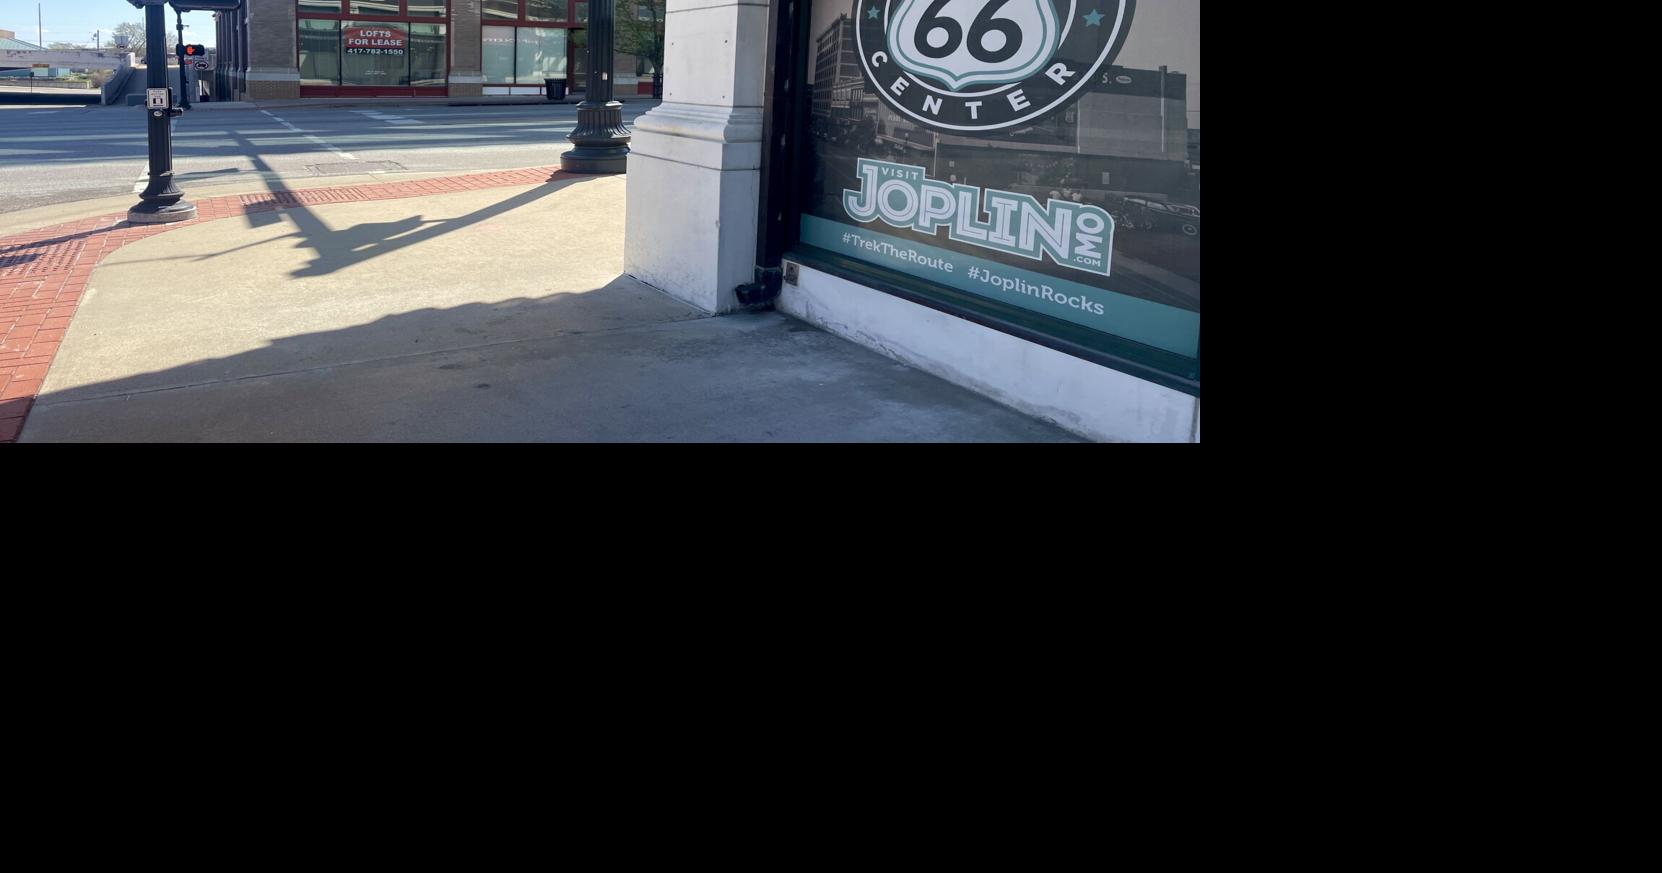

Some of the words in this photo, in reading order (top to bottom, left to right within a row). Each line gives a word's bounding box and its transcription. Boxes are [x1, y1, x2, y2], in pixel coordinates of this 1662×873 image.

[914, 0, 1023, 63] 66
[871, 50, 1076, 119] CENTER
[881, 166, 919, 181] VISIT
[847, 164, 1073, 260] JOPLIN
[1074, 212, 1105, 259] MO
[842, 231, 954, 274] #TrekTheRoute
[1073, 256, 1101, 267] .COM
[968, 265, 1105, 316] #JoplinRocks
